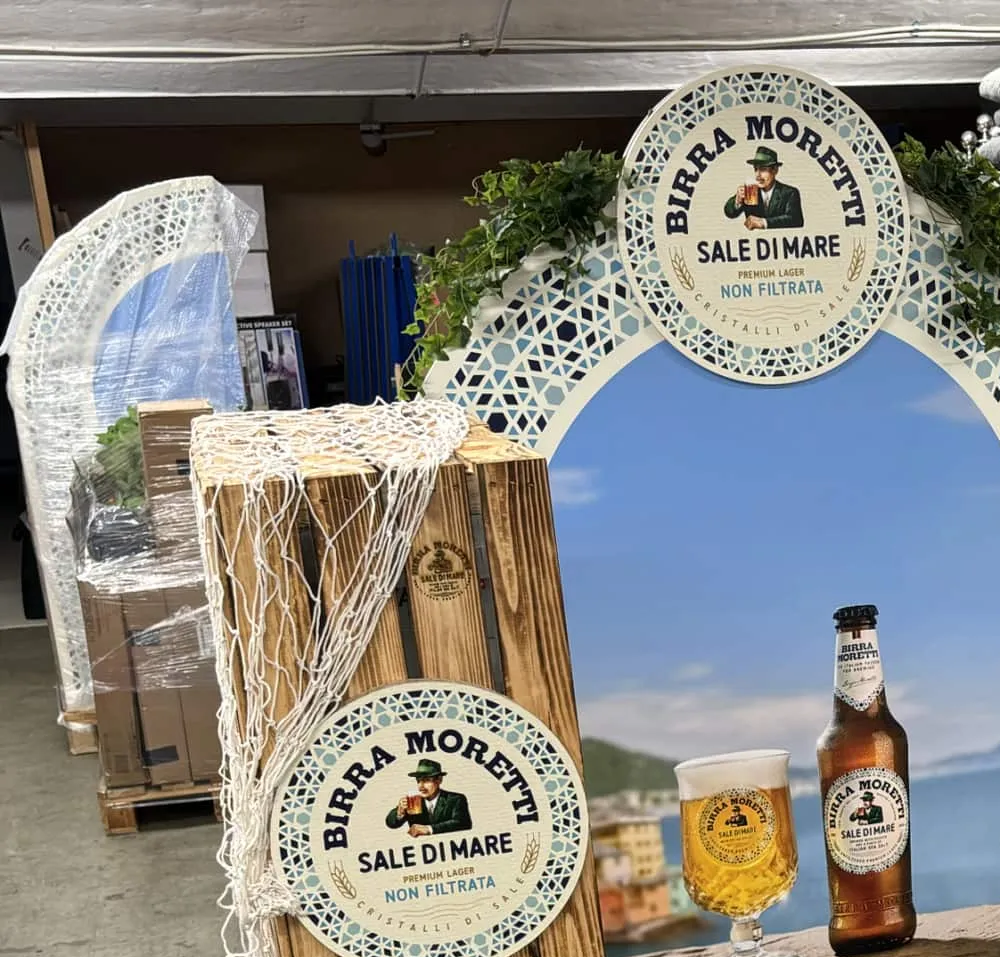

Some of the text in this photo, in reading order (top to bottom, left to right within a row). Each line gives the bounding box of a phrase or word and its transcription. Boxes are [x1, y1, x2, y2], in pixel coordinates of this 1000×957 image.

[666, 116, 866, 235] BIRRA MORETTI
[697, 235, 841, 263] SALE DI MARE
[738, 268, 805, 280] PREMIUM LAGER
[721, 279, 824, 298] NON FILTRATA
[694, 284, 850, 335] CRISTALLI DI SALE
[838, 650, 879, 662] MORETTI
[841, 642, 873, 653] BIRRA
[323, 729, 539, 850] BIRRA MORETTI
[829, 779, 905, 828] BIRRA MORETTI
[841, 823, 895, 839] SALE DI MARE
[358, 832, 513, 873] SALE DI MARE
[385, 875, 496, 903] NON FILTRATA
[403, 866, 475, 884] PREMIUM LAGER
[356, 877, 525, 933] CRISTALLI DI SALE
